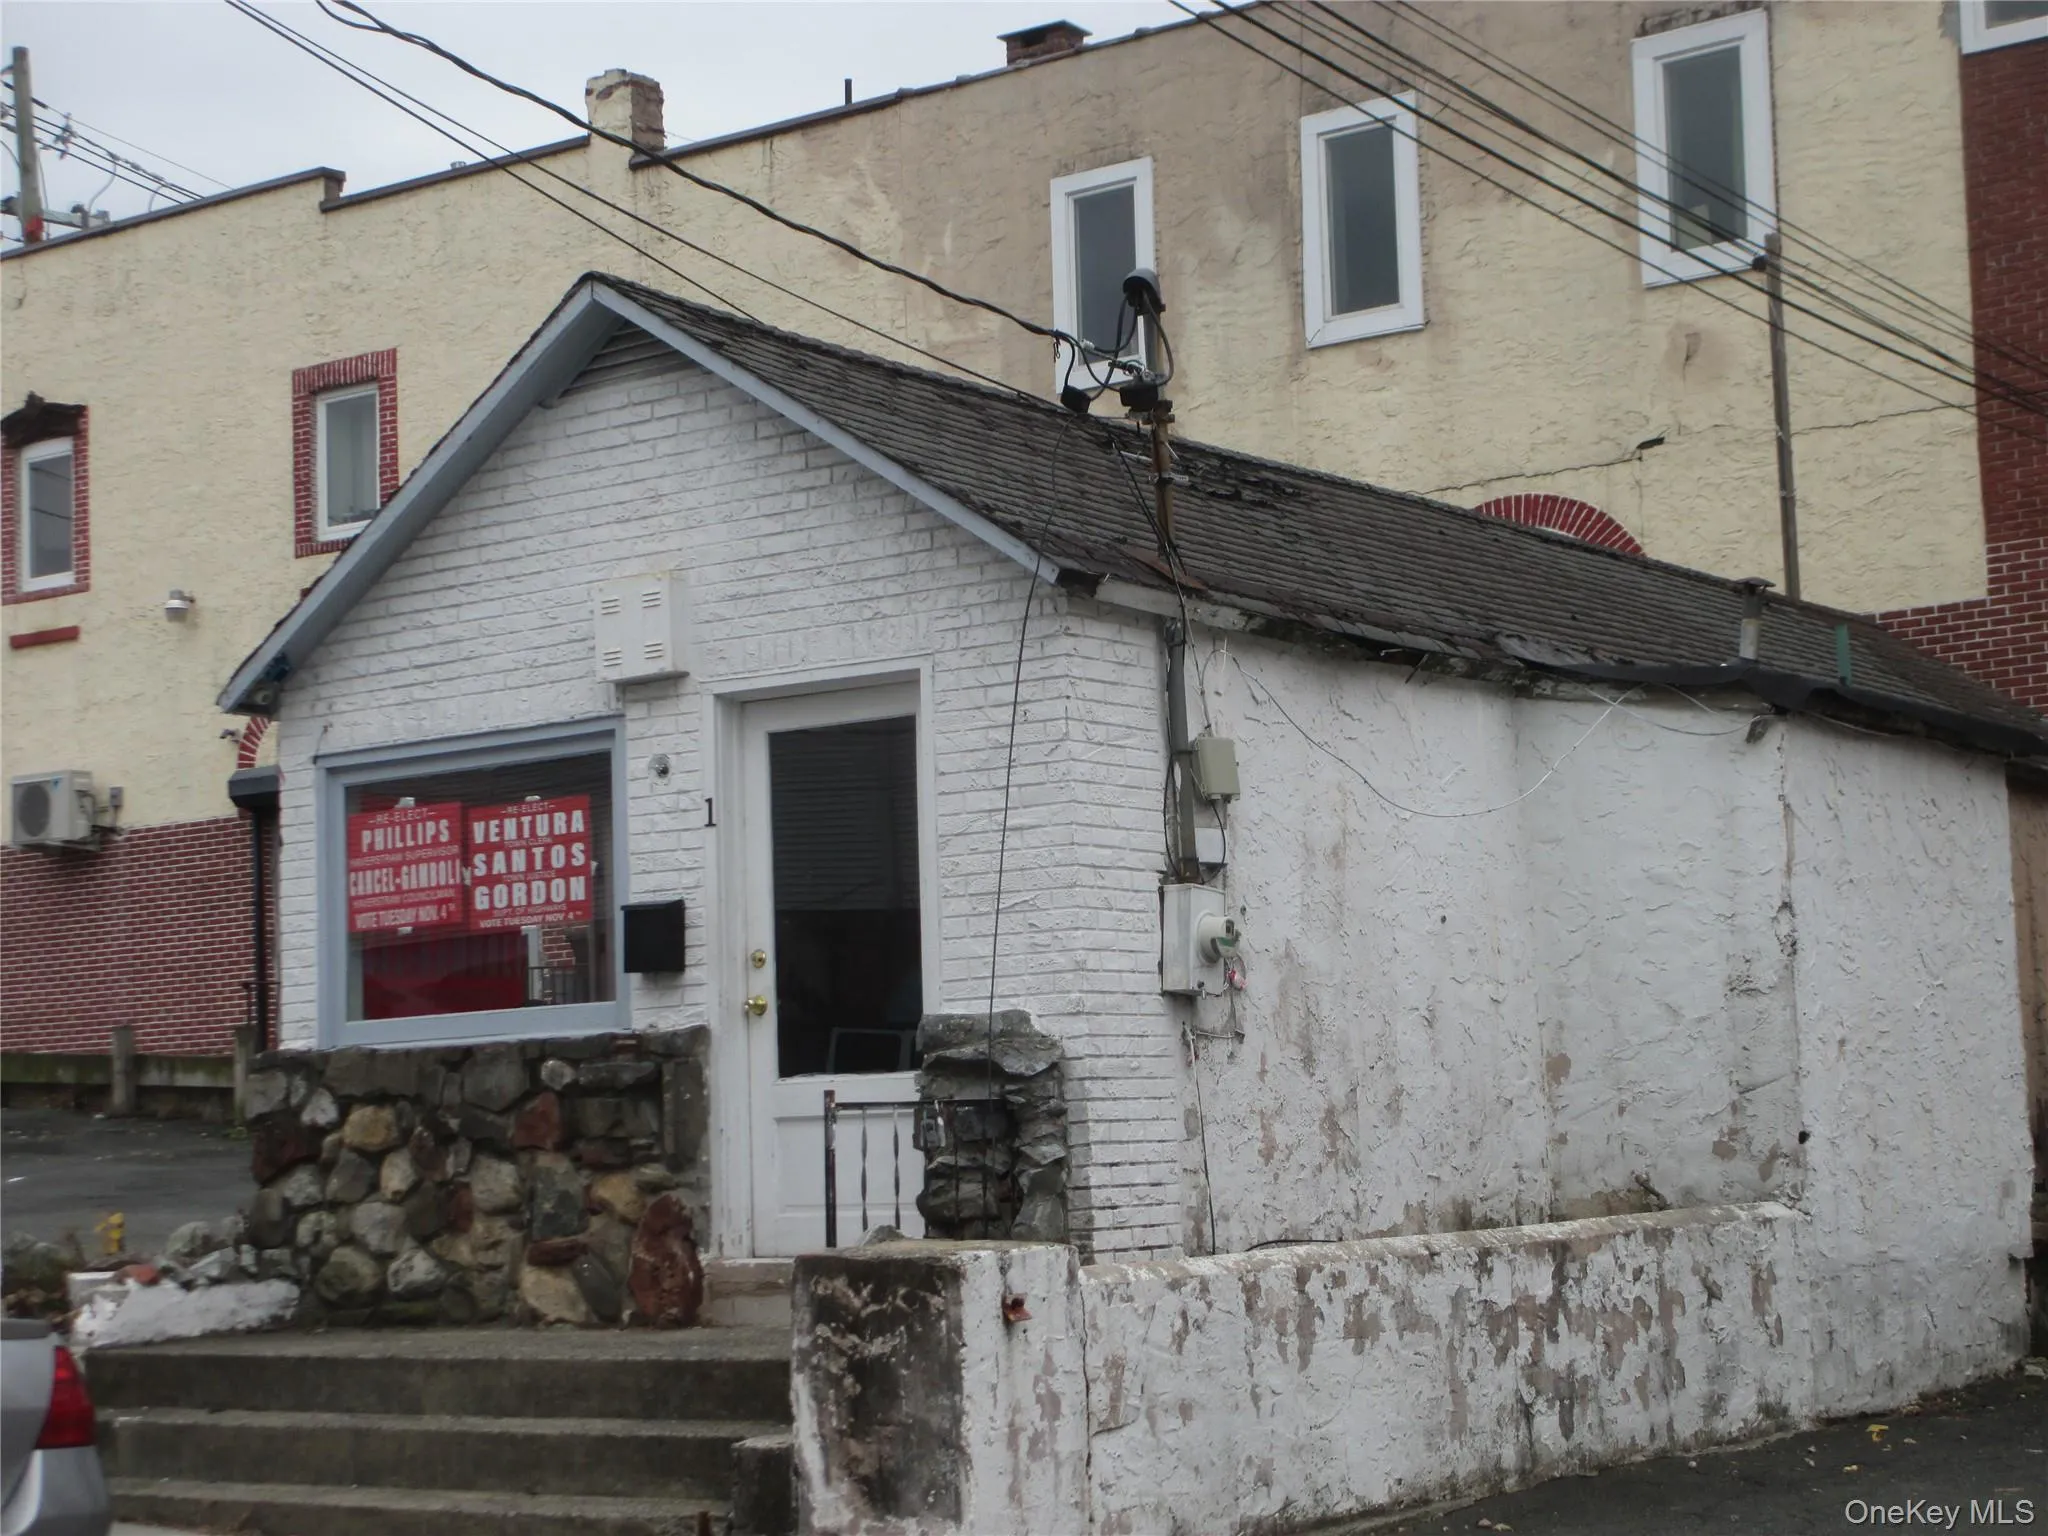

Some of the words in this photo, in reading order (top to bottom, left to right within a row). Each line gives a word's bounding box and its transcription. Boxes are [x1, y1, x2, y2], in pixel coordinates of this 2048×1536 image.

[473, 810, 585, 844] VENTURA
[704, 797, 717, 828] 1
[361, 819, 450, 852] PHILLIPS
[473, 842, 586, 876] SANTOS
[474, 876, 586, 910] GORDON
[355, 912, 378, 928] VOTE
[480, 918, 503, 928] VOTE
[504, 914, 544, 926] TUESDAY
